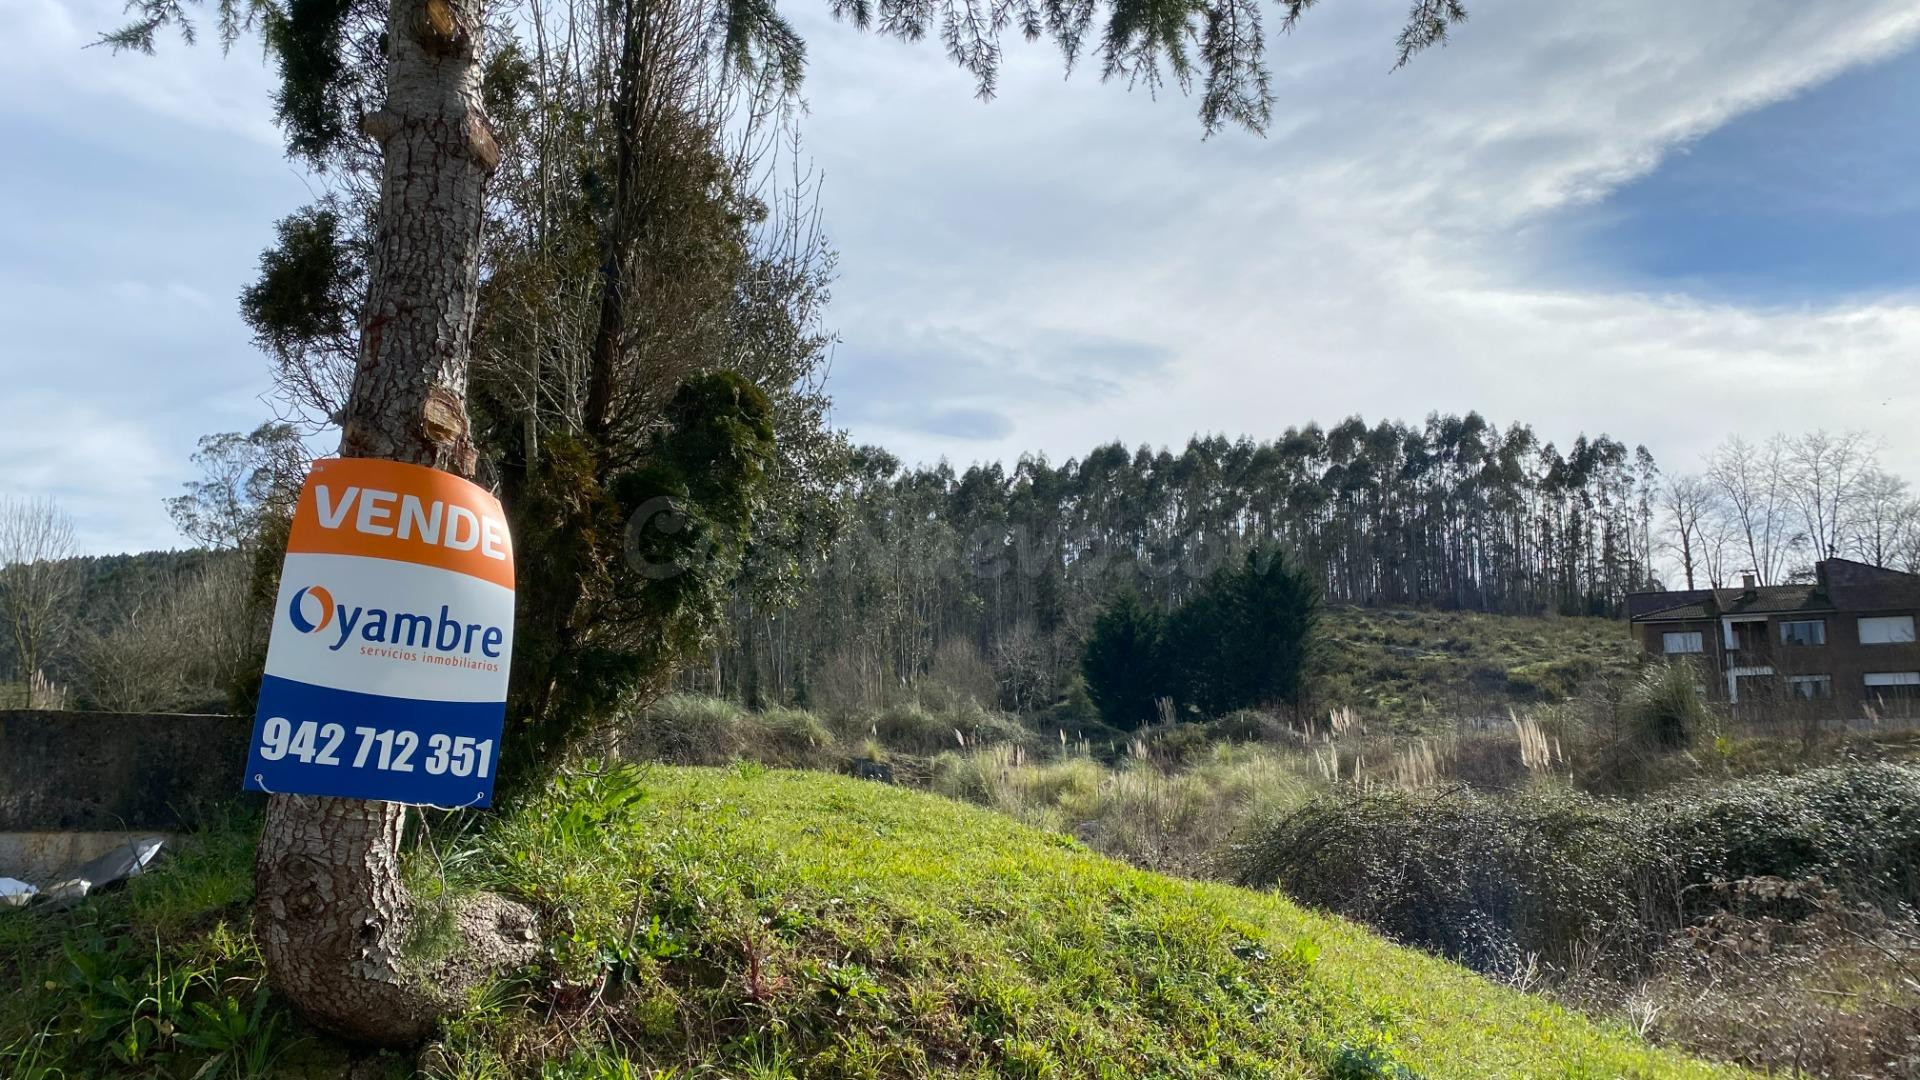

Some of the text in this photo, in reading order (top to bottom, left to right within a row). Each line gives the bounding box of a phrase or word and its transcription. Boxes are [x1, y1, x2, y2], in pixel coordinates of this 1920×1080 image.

[315, 484, 506, 561] VENDE
[289, 585, 503, 658] Oyambre
[360, 645, 499, 672] servicios inmobiliarios
[260, 717, 494, 778] 942 712 351
